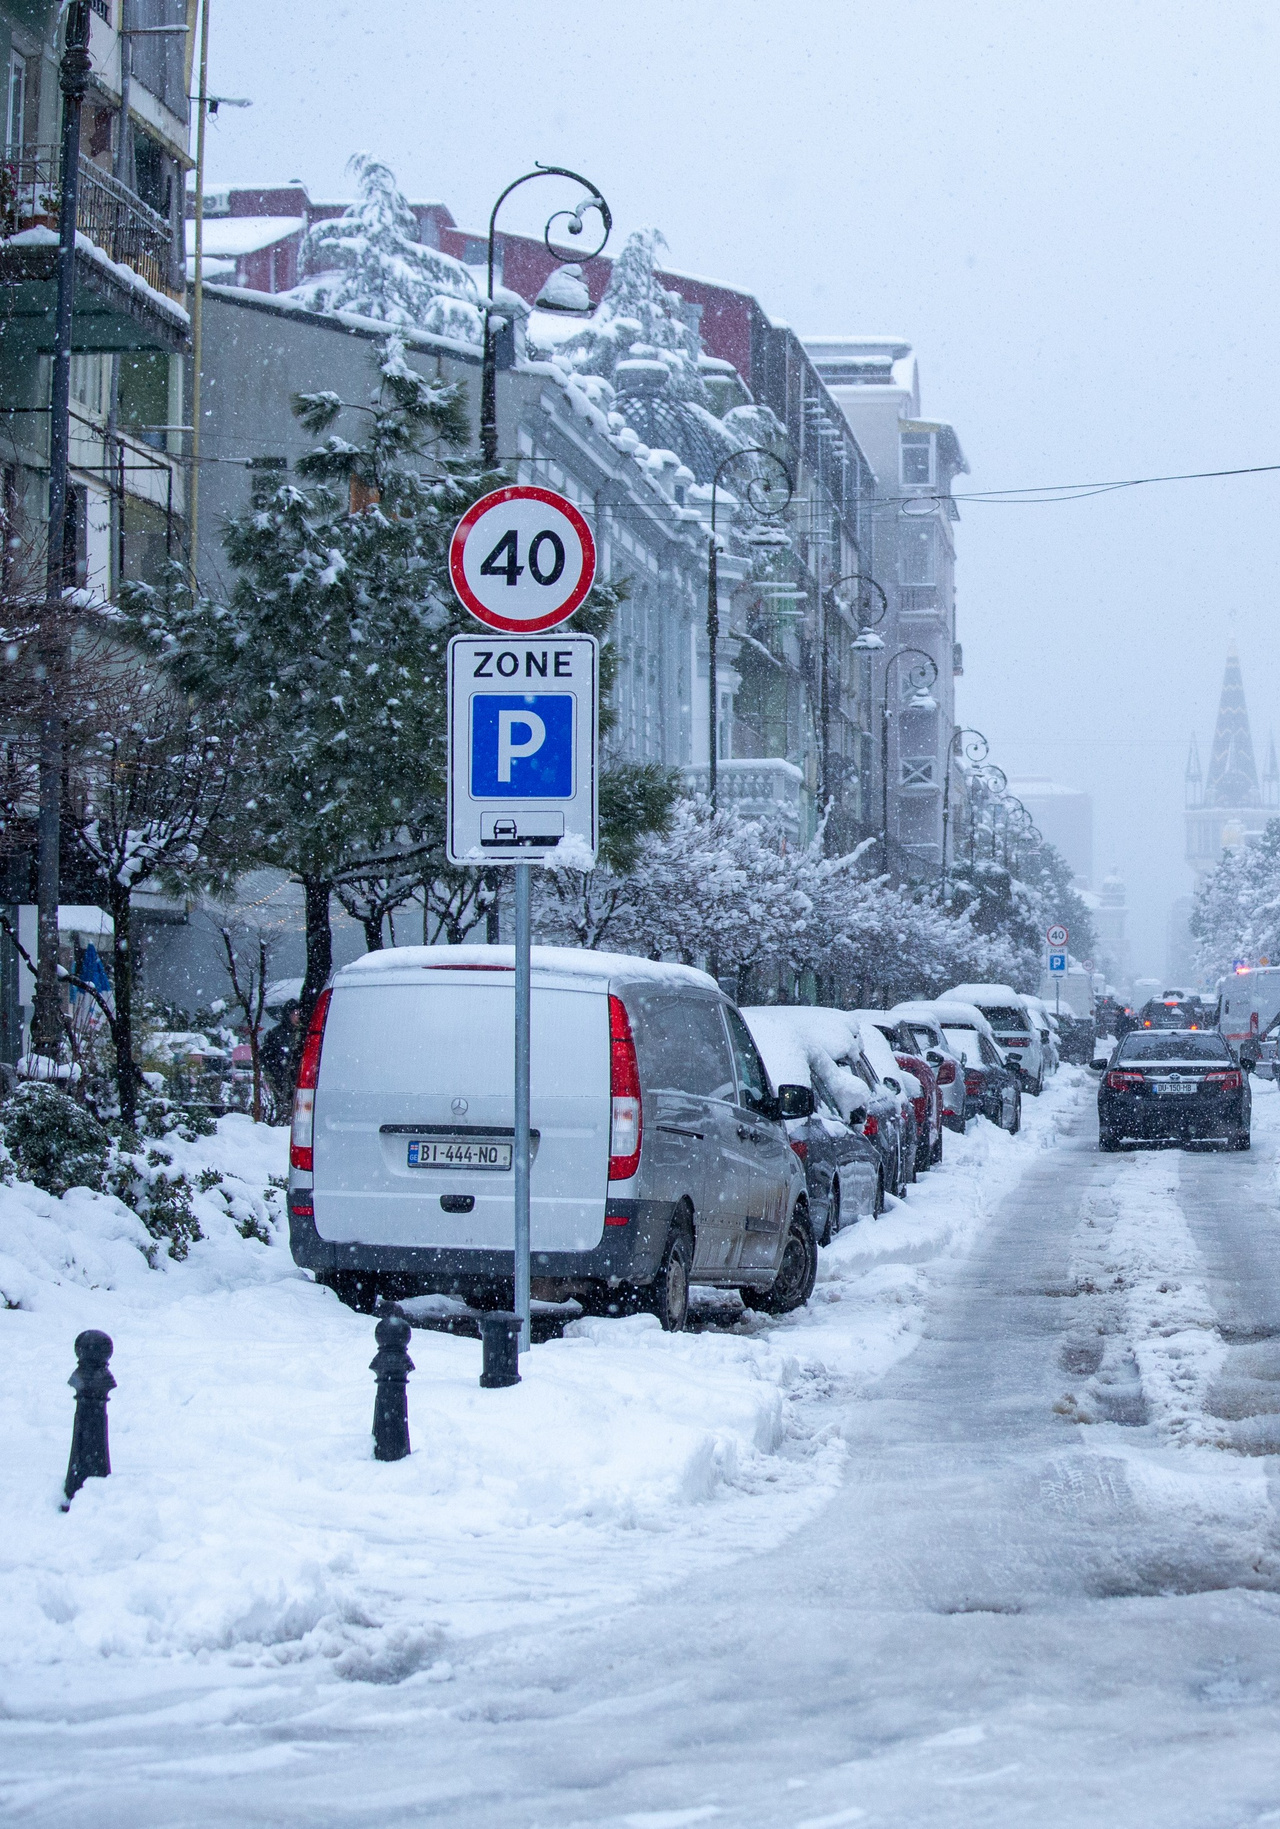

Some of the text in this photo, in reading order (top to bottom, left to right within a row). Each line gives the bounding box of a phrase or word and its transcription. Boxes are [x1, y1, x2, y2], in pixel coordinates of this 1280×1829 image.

[480, 529, 565, 587] 40
[473, 651, 573, 678] ZONE
[497, 709, 546, 783] P
[1051, 931, 1064, 940] 40
[1053, 957, 1061, 969] P
[420, 1145, 498, 1163] BI-444-NO
